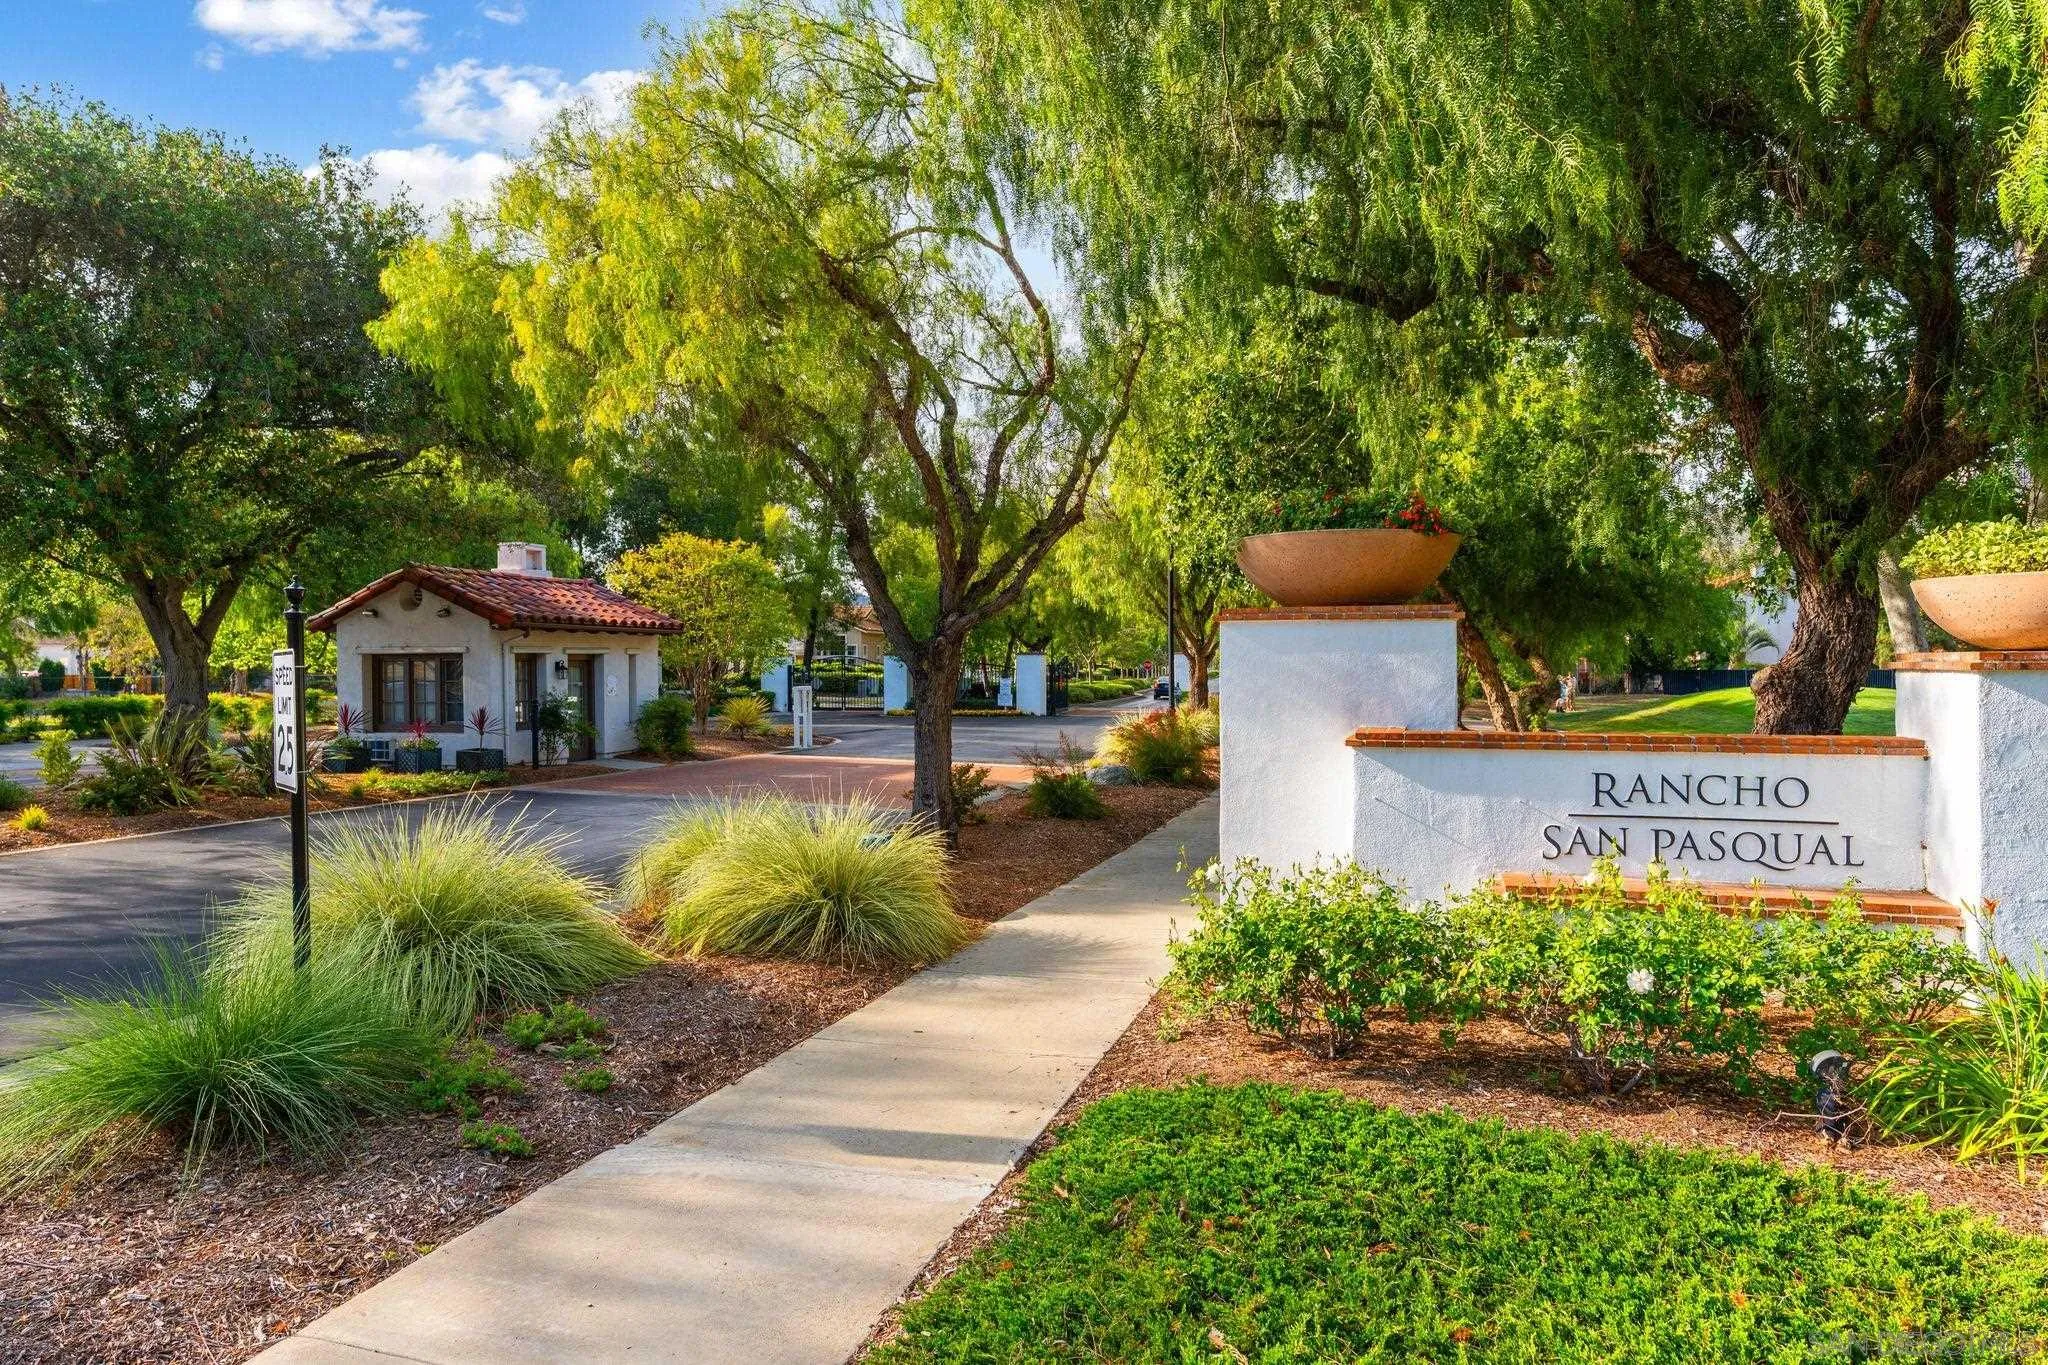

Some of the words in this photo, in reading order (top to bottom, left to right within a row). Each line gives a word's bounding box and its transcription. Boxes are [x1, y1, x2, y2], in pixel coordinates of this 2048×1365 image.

[275, 665, 293, 686] SPEED
[277, 696, 292, 715] LIMIT
[277, 724, 294, 775] 25
[1592, 772, 1810, 809] RANCHO
[1542, 825, 1628, 860] SAN
[1651, 828, 1865, 871] PASQUAL
